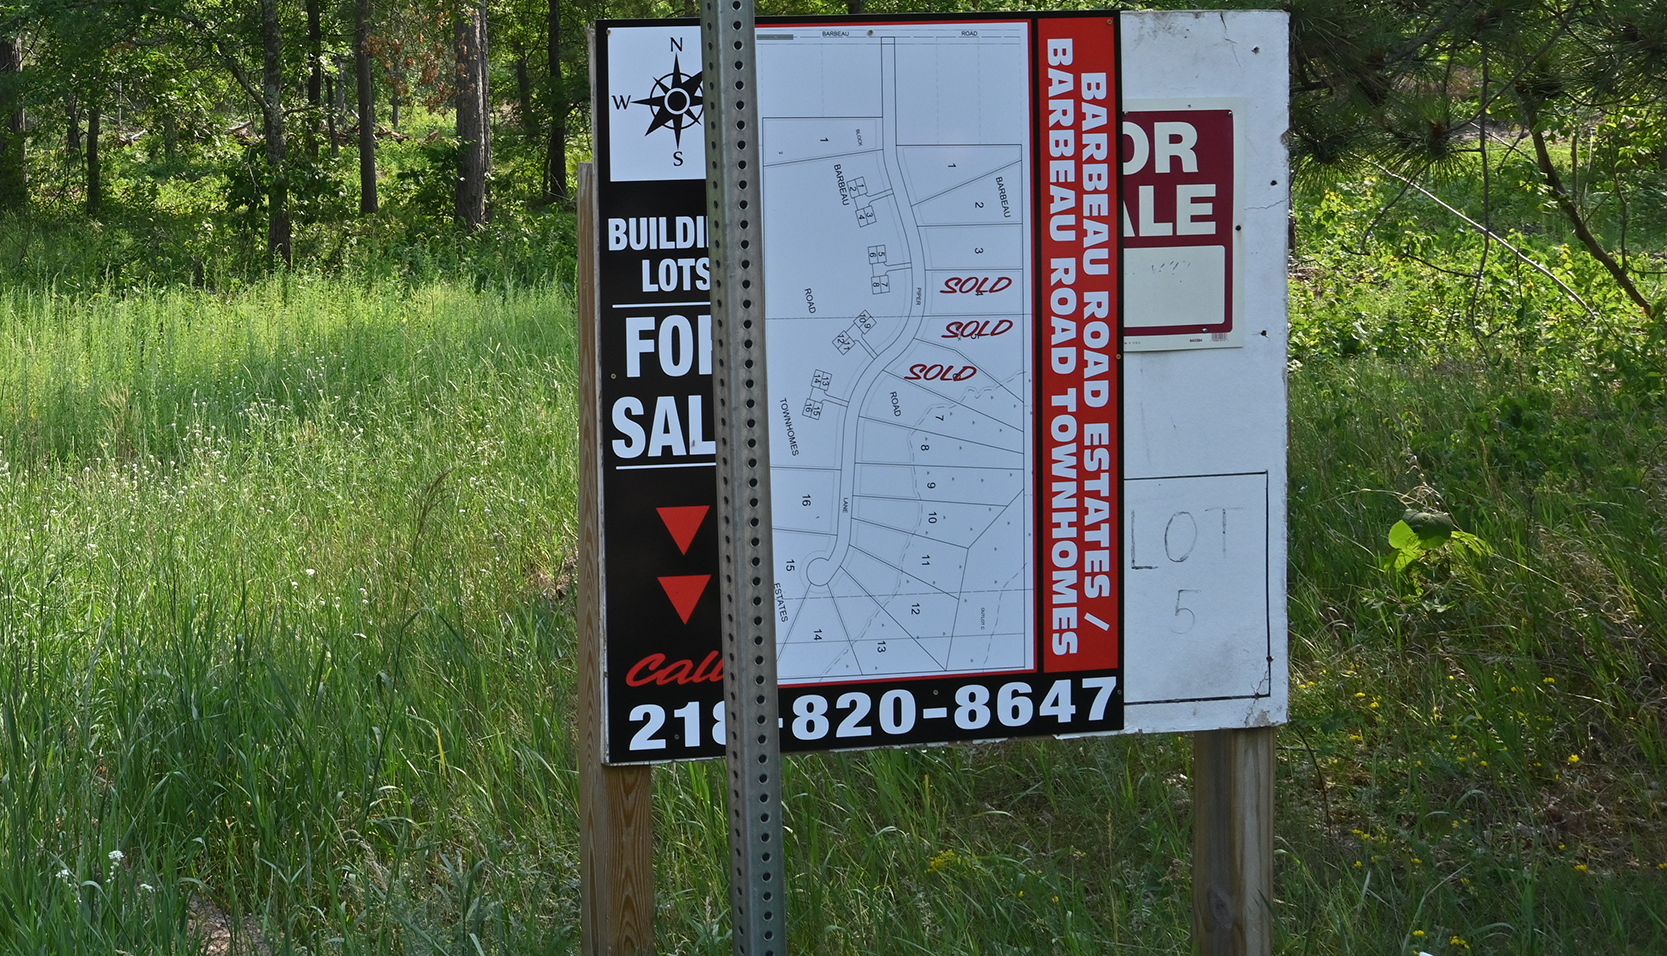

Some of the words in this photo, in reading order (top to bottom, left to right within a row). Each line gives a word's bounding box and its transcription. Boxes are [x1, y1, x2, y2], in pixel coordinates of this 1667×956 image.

[670, 37, 683, 52] N
[611, 95, 632, 110] W
[1047, 38, 1076, 242] BARBEAU
[673, 151, 684, 166] S
[833, 164, 850, 206] BARBEAU
[1081, 72, 1109, 275] BARBEAU
[995, 176, 1011, 218] BARBEAU
[608, 215, 709, 251] BUILDI
[642, 257, 711, 292] LOTS
[939, 276, 1012, 294] SOLD
[804, 287, 817, 314] ROAD
[858, 313, 866, 323] 10
[1050, 257, 1077, 375] ROAD
[837, 334, 845, 344] 12
[940, 319, 1014, 339] SOLD
[1083, 291, 1110, 408] ROAD
[814, 374, 821, 384] 14
[822, 377, 829, 386] 13
[904, 363, 977, 382] SOLD
[805, 403, 813, 413] 16
[813, 406, 820, 416] 15
[889, 391, 902, 417] ROAD
[780, 398, 800, 457] TOWNHOMES
[801, 494, 812, 507] 16
[1084, 422, 1111, 599] ESTATES
[928, 511, 937, 524] 10
[1051, 388, 1078, 656] TOWNHOMES
[1131, 507, 1244, 569] LOT
[785, 558, 796, 572] 15
[921, 554, 930, 566] 11
[774, 582, 789, 623] ESTATES
[911, 602, 921, 615] 12
[1170, 589, 1201, 634] 5
[813, 628, 823, 641] 14
[877, 640, 886, 653] 13
[629, 676, 1118, 752] 21820-8647
